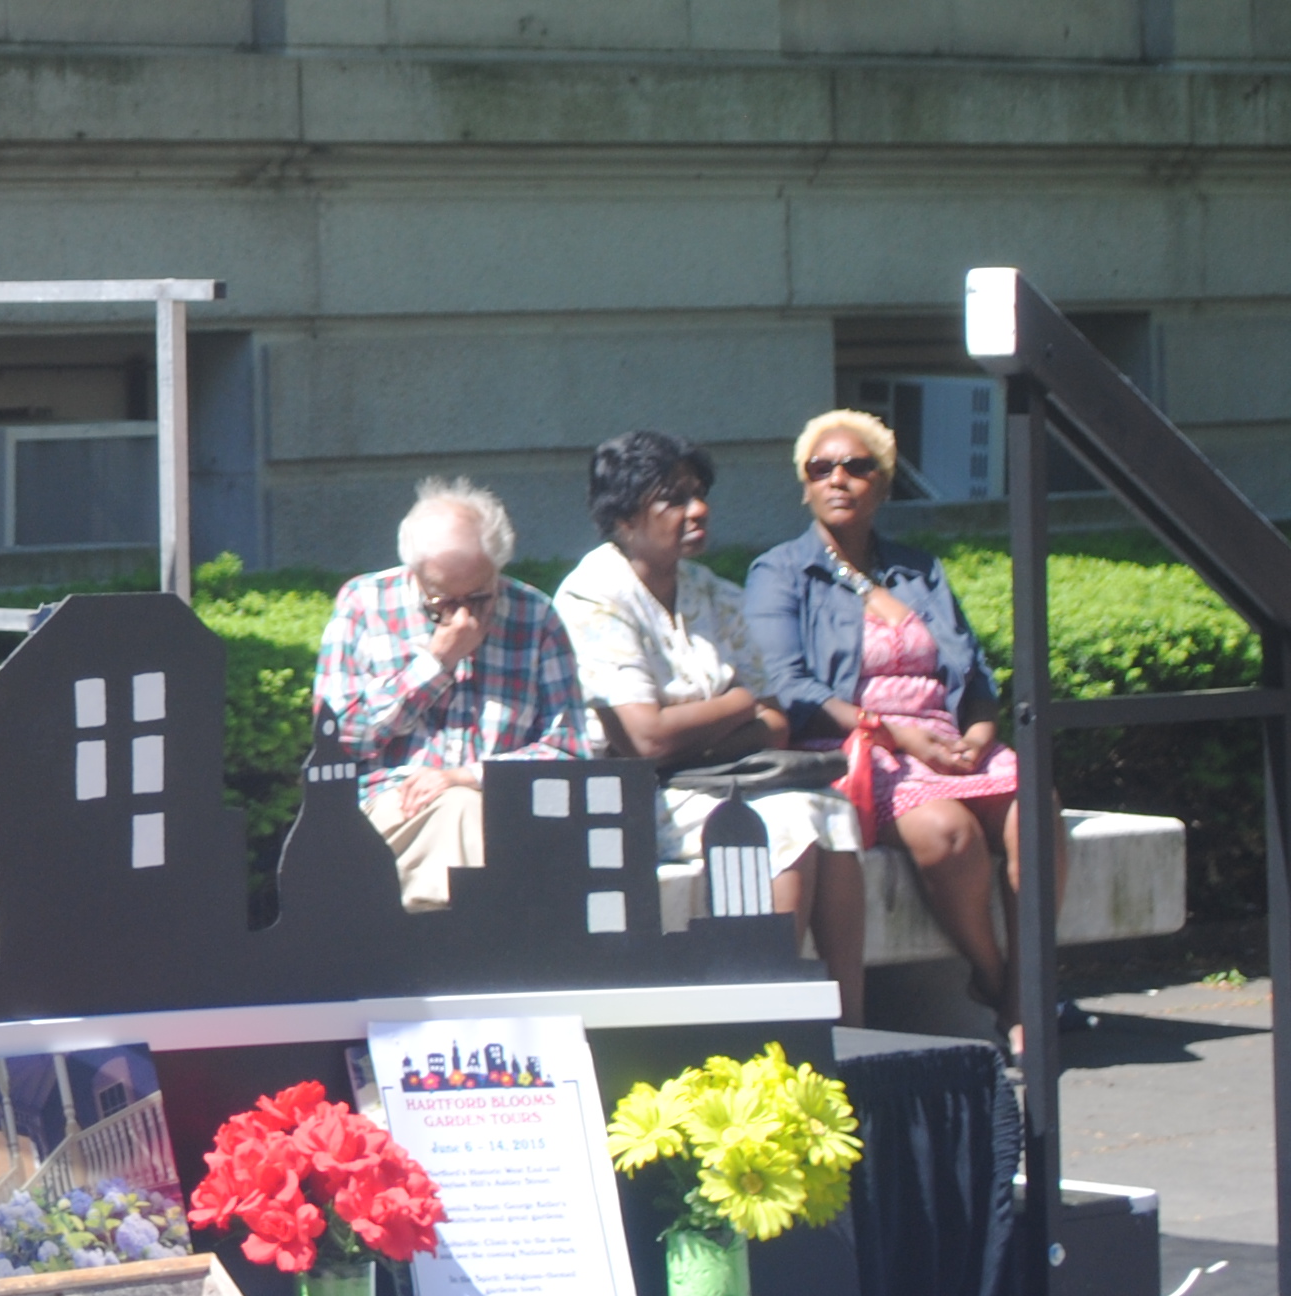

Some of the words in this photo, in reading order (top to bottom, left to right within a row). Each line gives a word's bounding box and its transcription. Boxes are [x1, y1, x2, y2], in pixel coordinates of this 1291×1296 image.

[406, 1096, 487, 1110] HARTFORD
[490, 1094, 556, 1108] BLOOMS
[424, 1114, 486, 1127] GARDEN
[490, 1112, 542, 1125] TOURS
[512, 1137, 545, 1151] 2015
